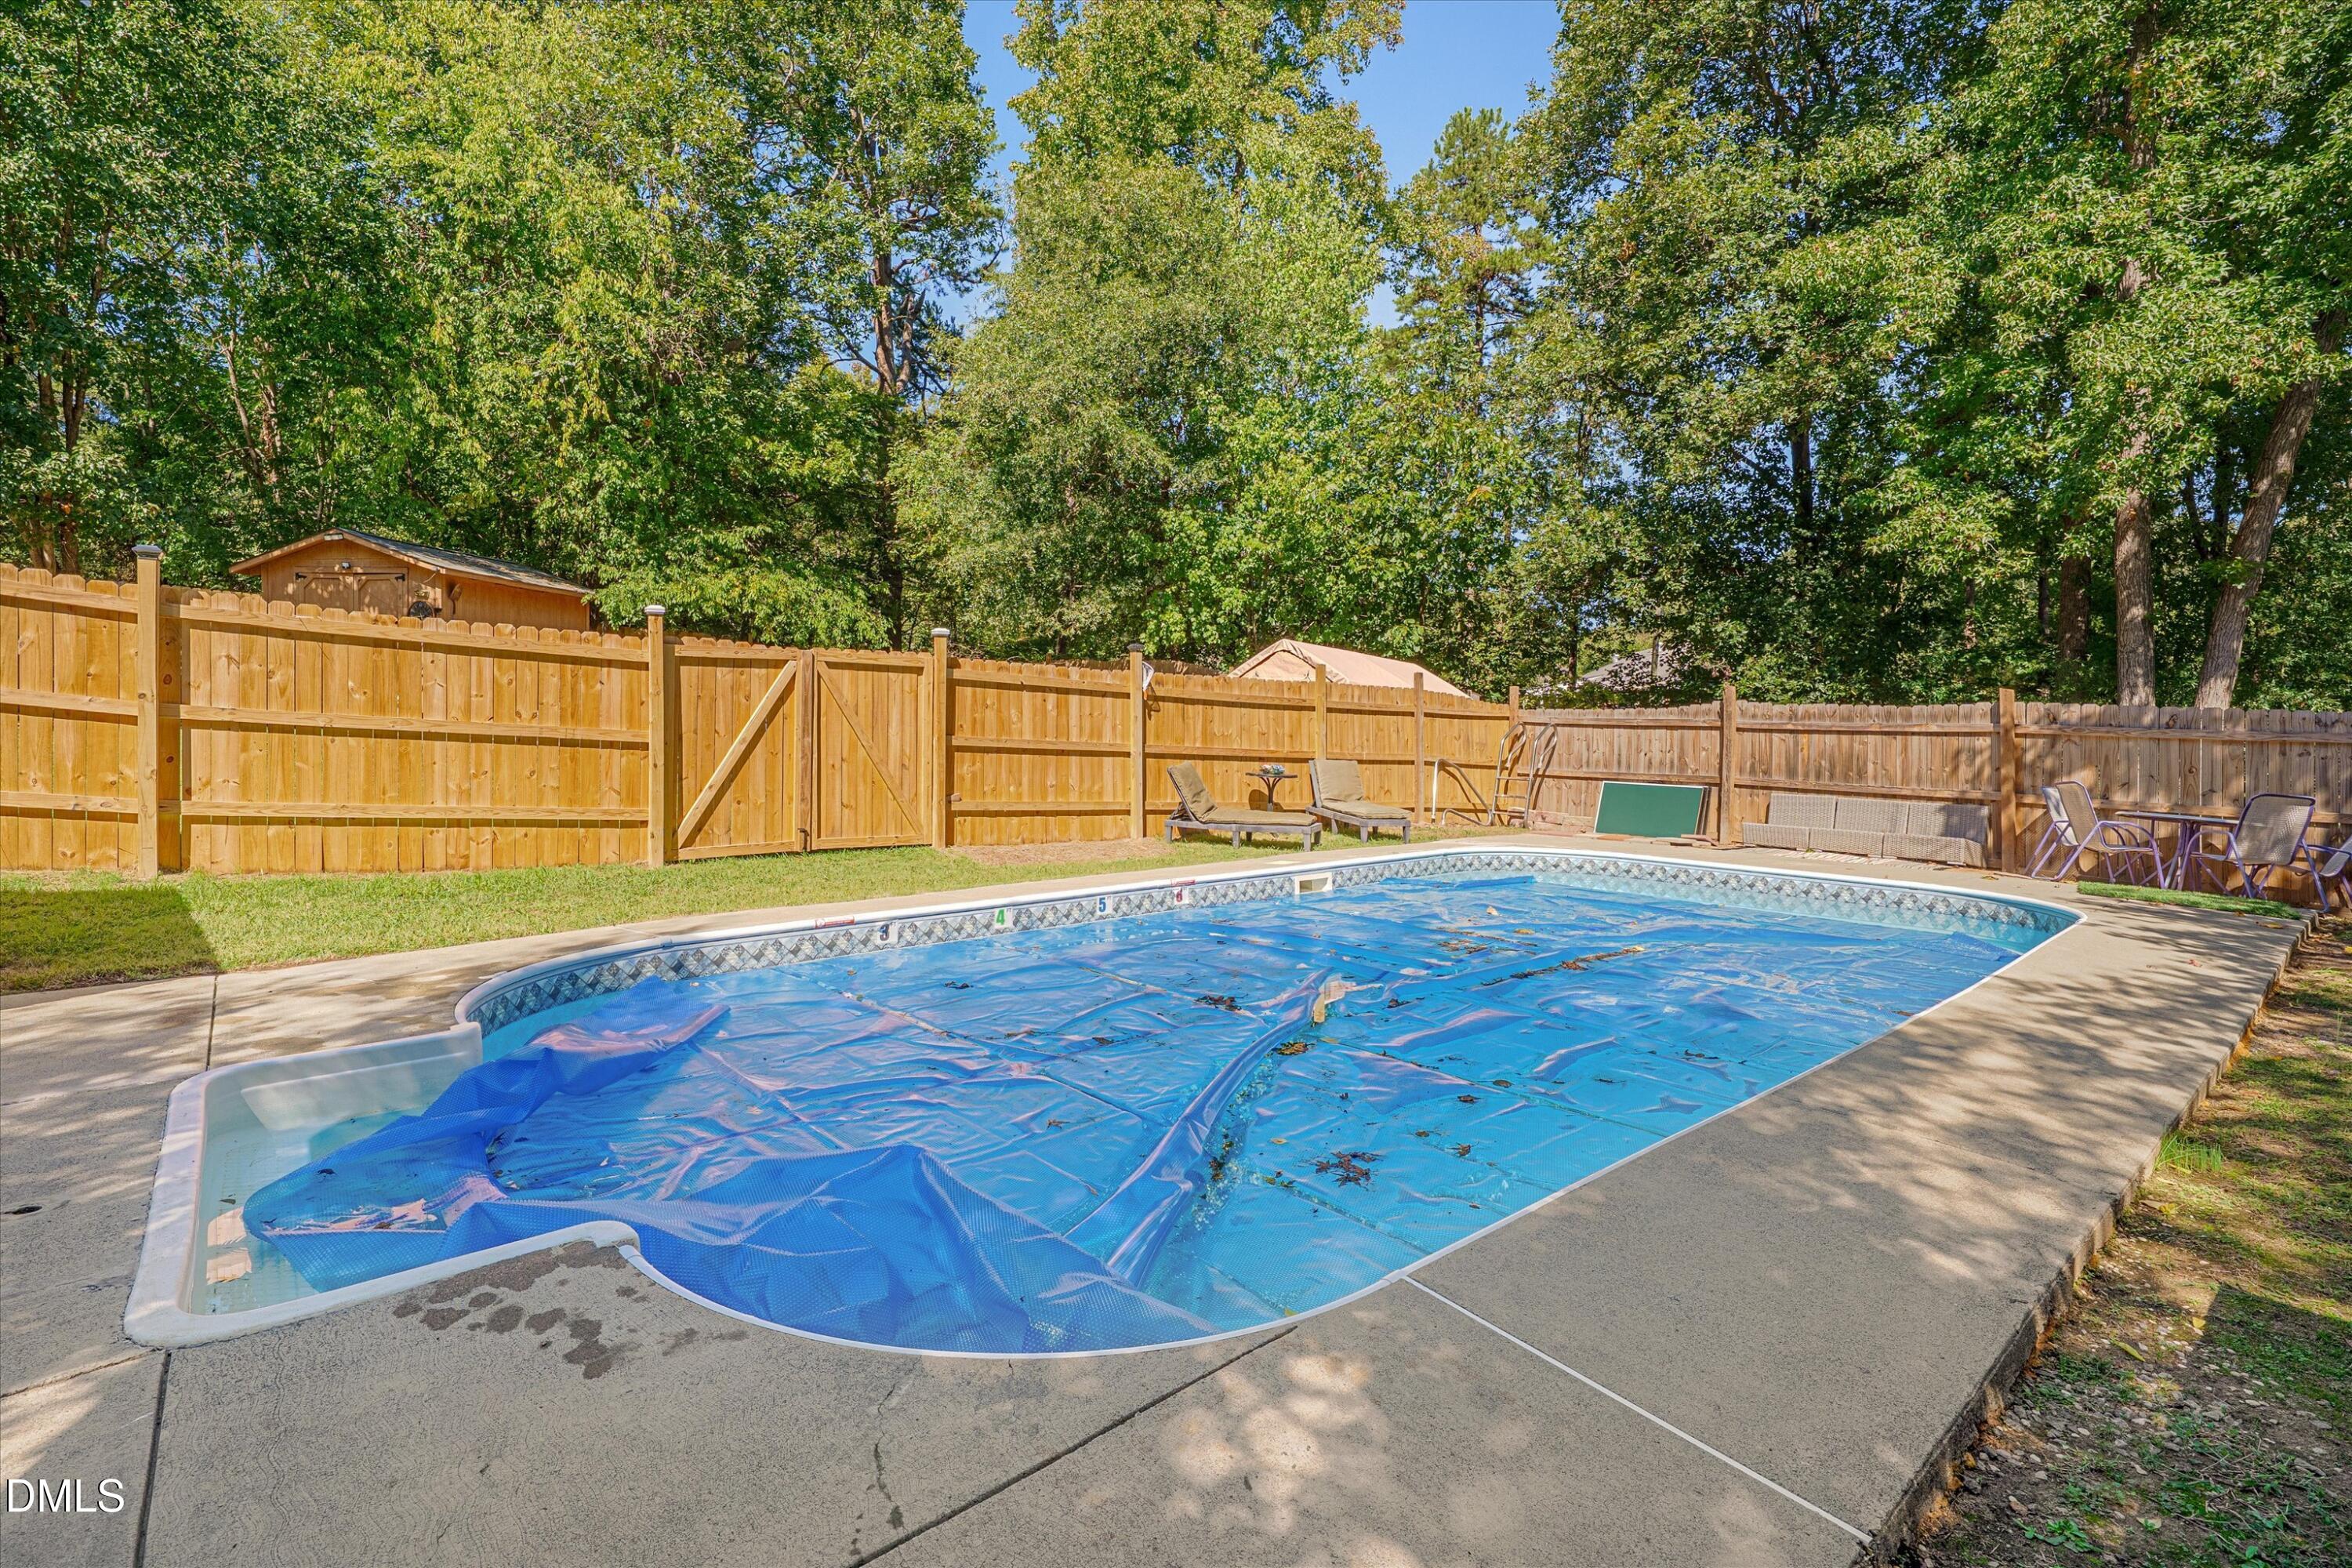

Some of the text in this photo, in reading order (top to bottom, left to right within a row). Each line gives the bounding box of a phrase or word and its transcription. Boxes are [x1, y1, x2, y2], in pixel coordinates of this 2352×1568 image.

[1098, 897, 1106, 913] 5
[996, 909, 1005, 925] 4
[879, 924, 890, 941] 3
